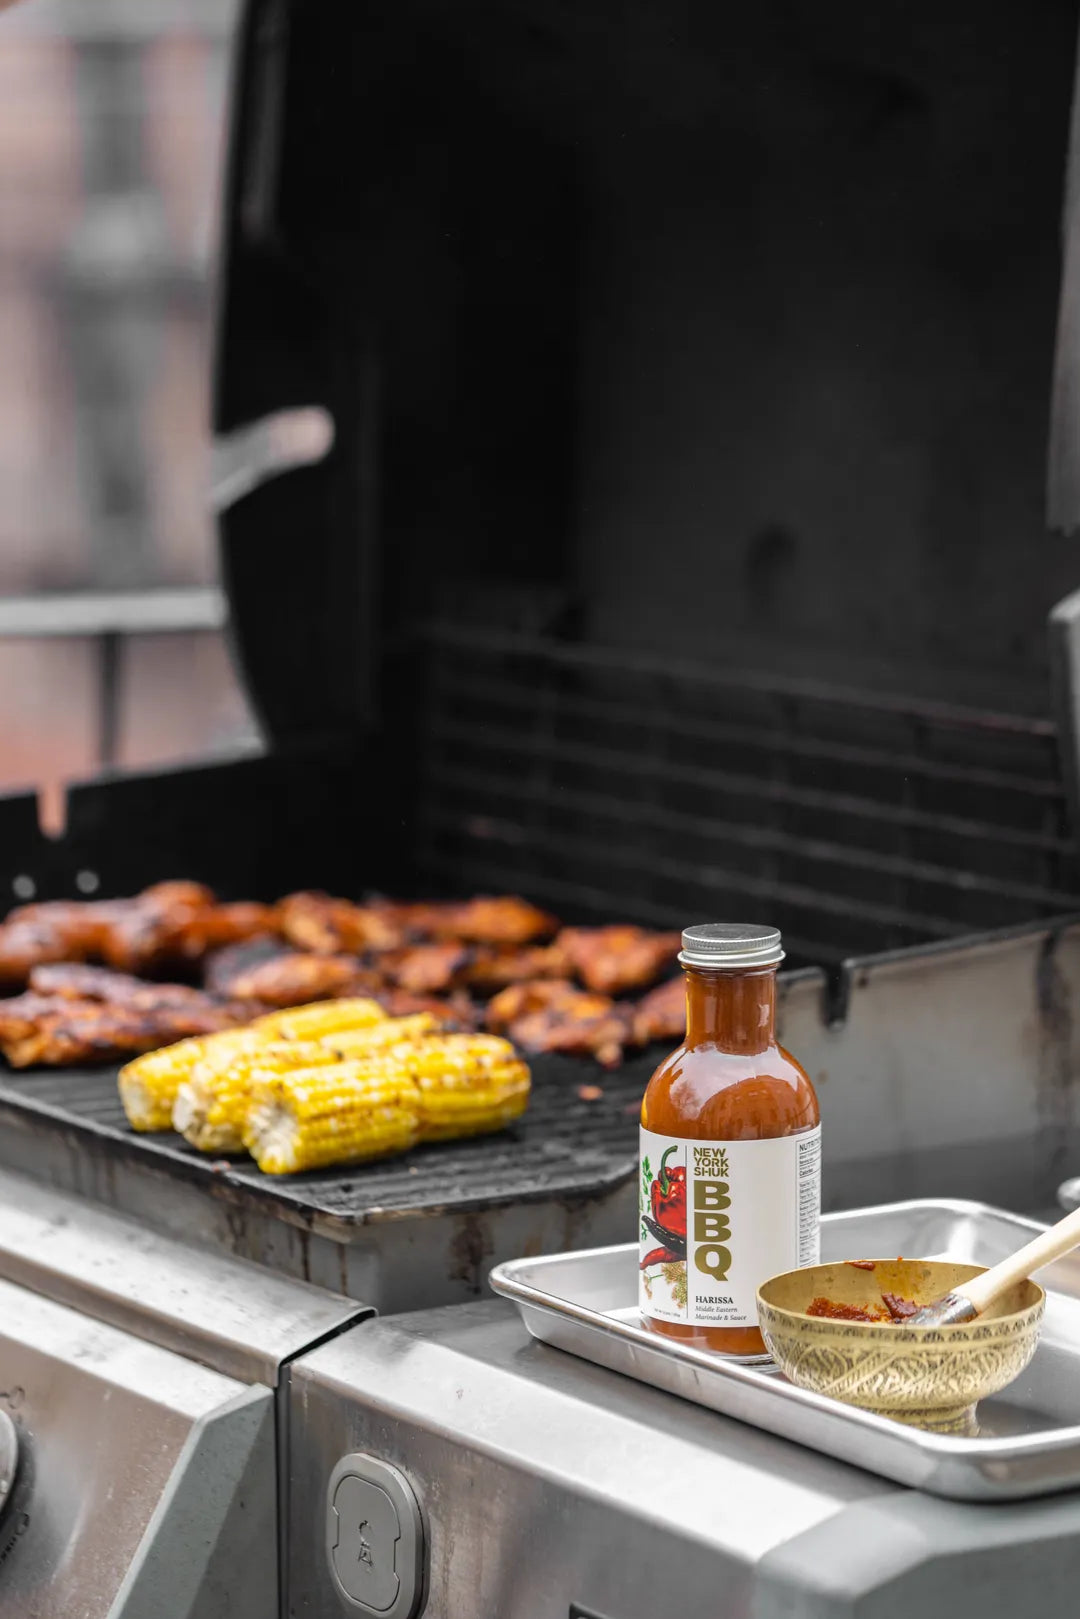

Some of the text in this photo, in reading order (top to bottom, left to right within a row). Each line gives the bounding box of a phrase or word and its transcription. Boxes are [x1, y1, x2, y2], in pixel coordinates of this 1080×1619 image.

[693, 1147, 726, 1158] NEW
[694, 1157, 729, 1168] YORK
[694, 1166, 730, 1178] SHUK
[695, 1295, 734, 1304] HARISSA
[695, 1313, 723, 1321] Marinade
